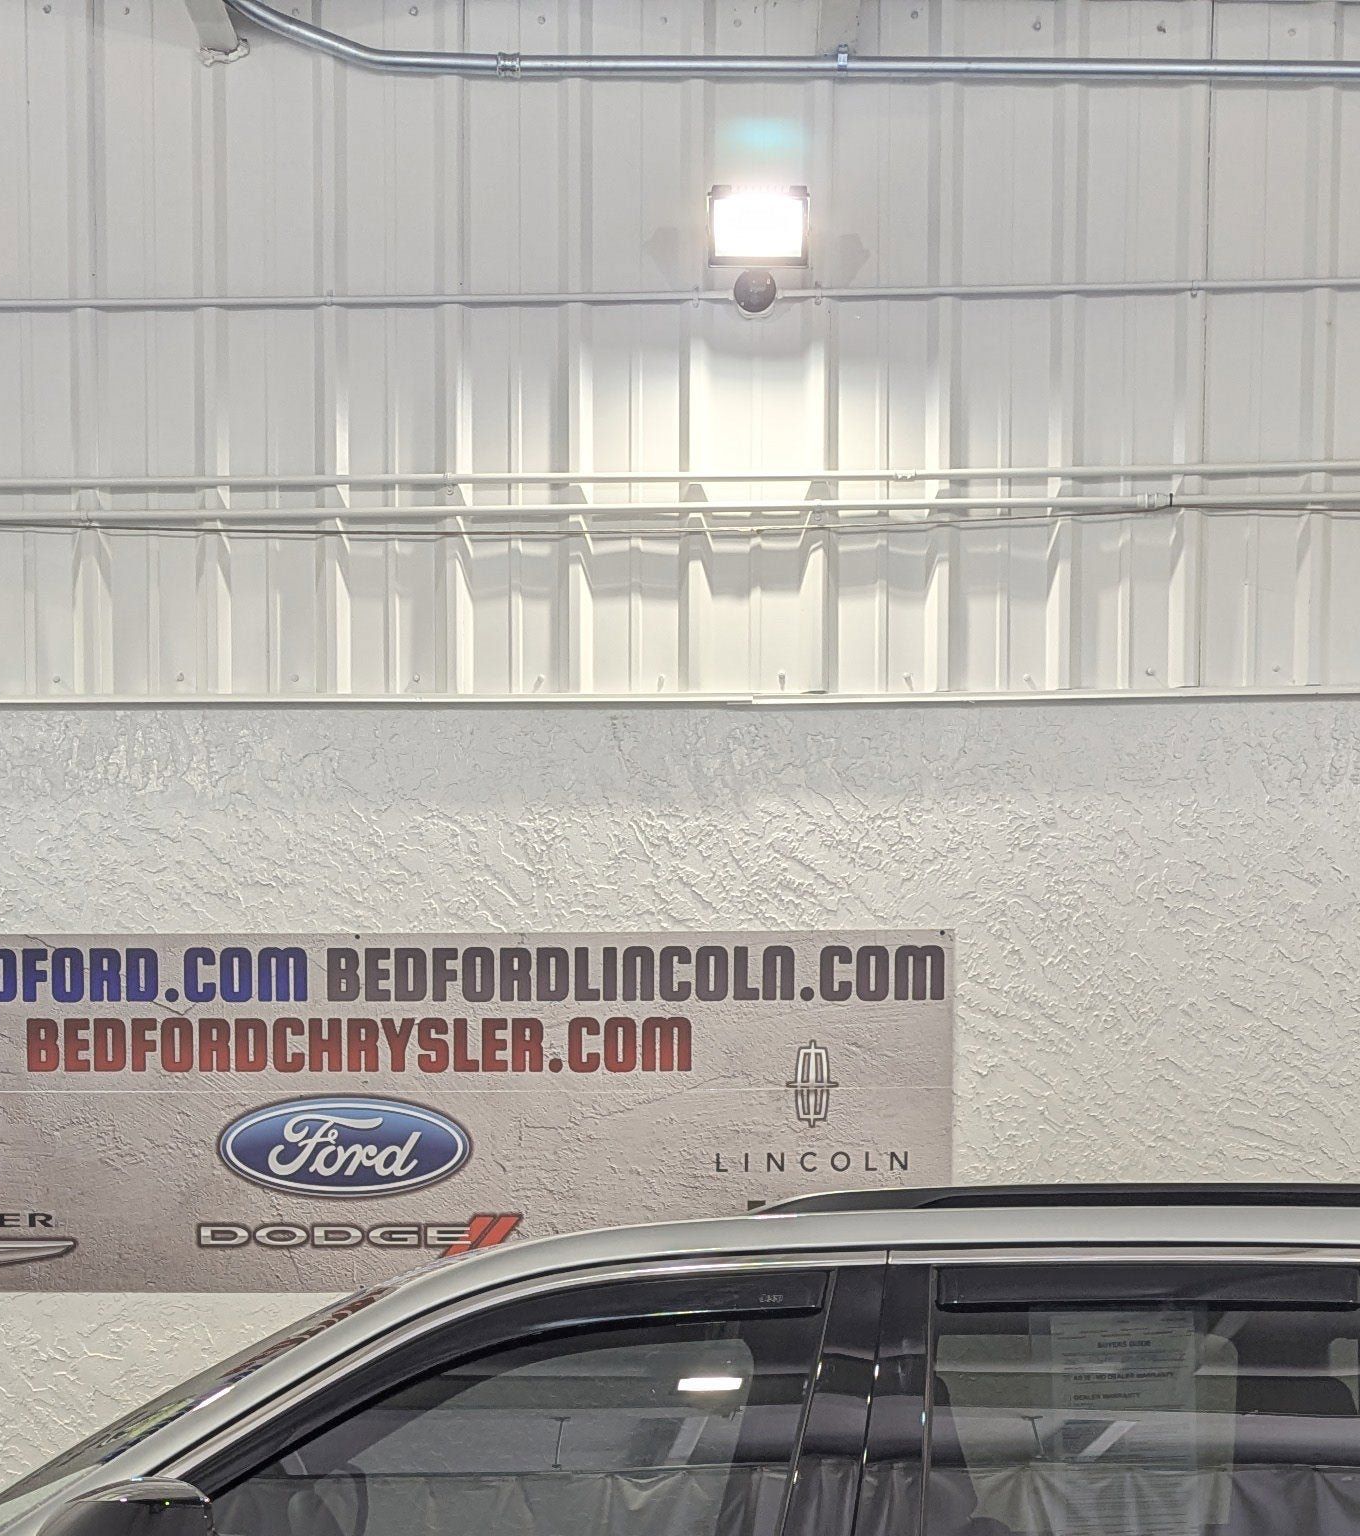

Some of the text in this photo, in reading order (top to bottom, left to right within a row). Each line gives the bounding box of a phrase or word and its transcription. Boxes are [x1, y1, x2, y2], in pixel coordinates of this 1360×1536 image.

[327, 945, 944, 1002] BEDFORDLINCOLN.COM
[26, 1017, 691, 1073] BEDFORDCHRYSLER.COM
[267, 1113, 422, 1177] Ford
[715, 1151, 908, 1173] LINCOLN
[198, 1223, 472, 1248] DODGE
